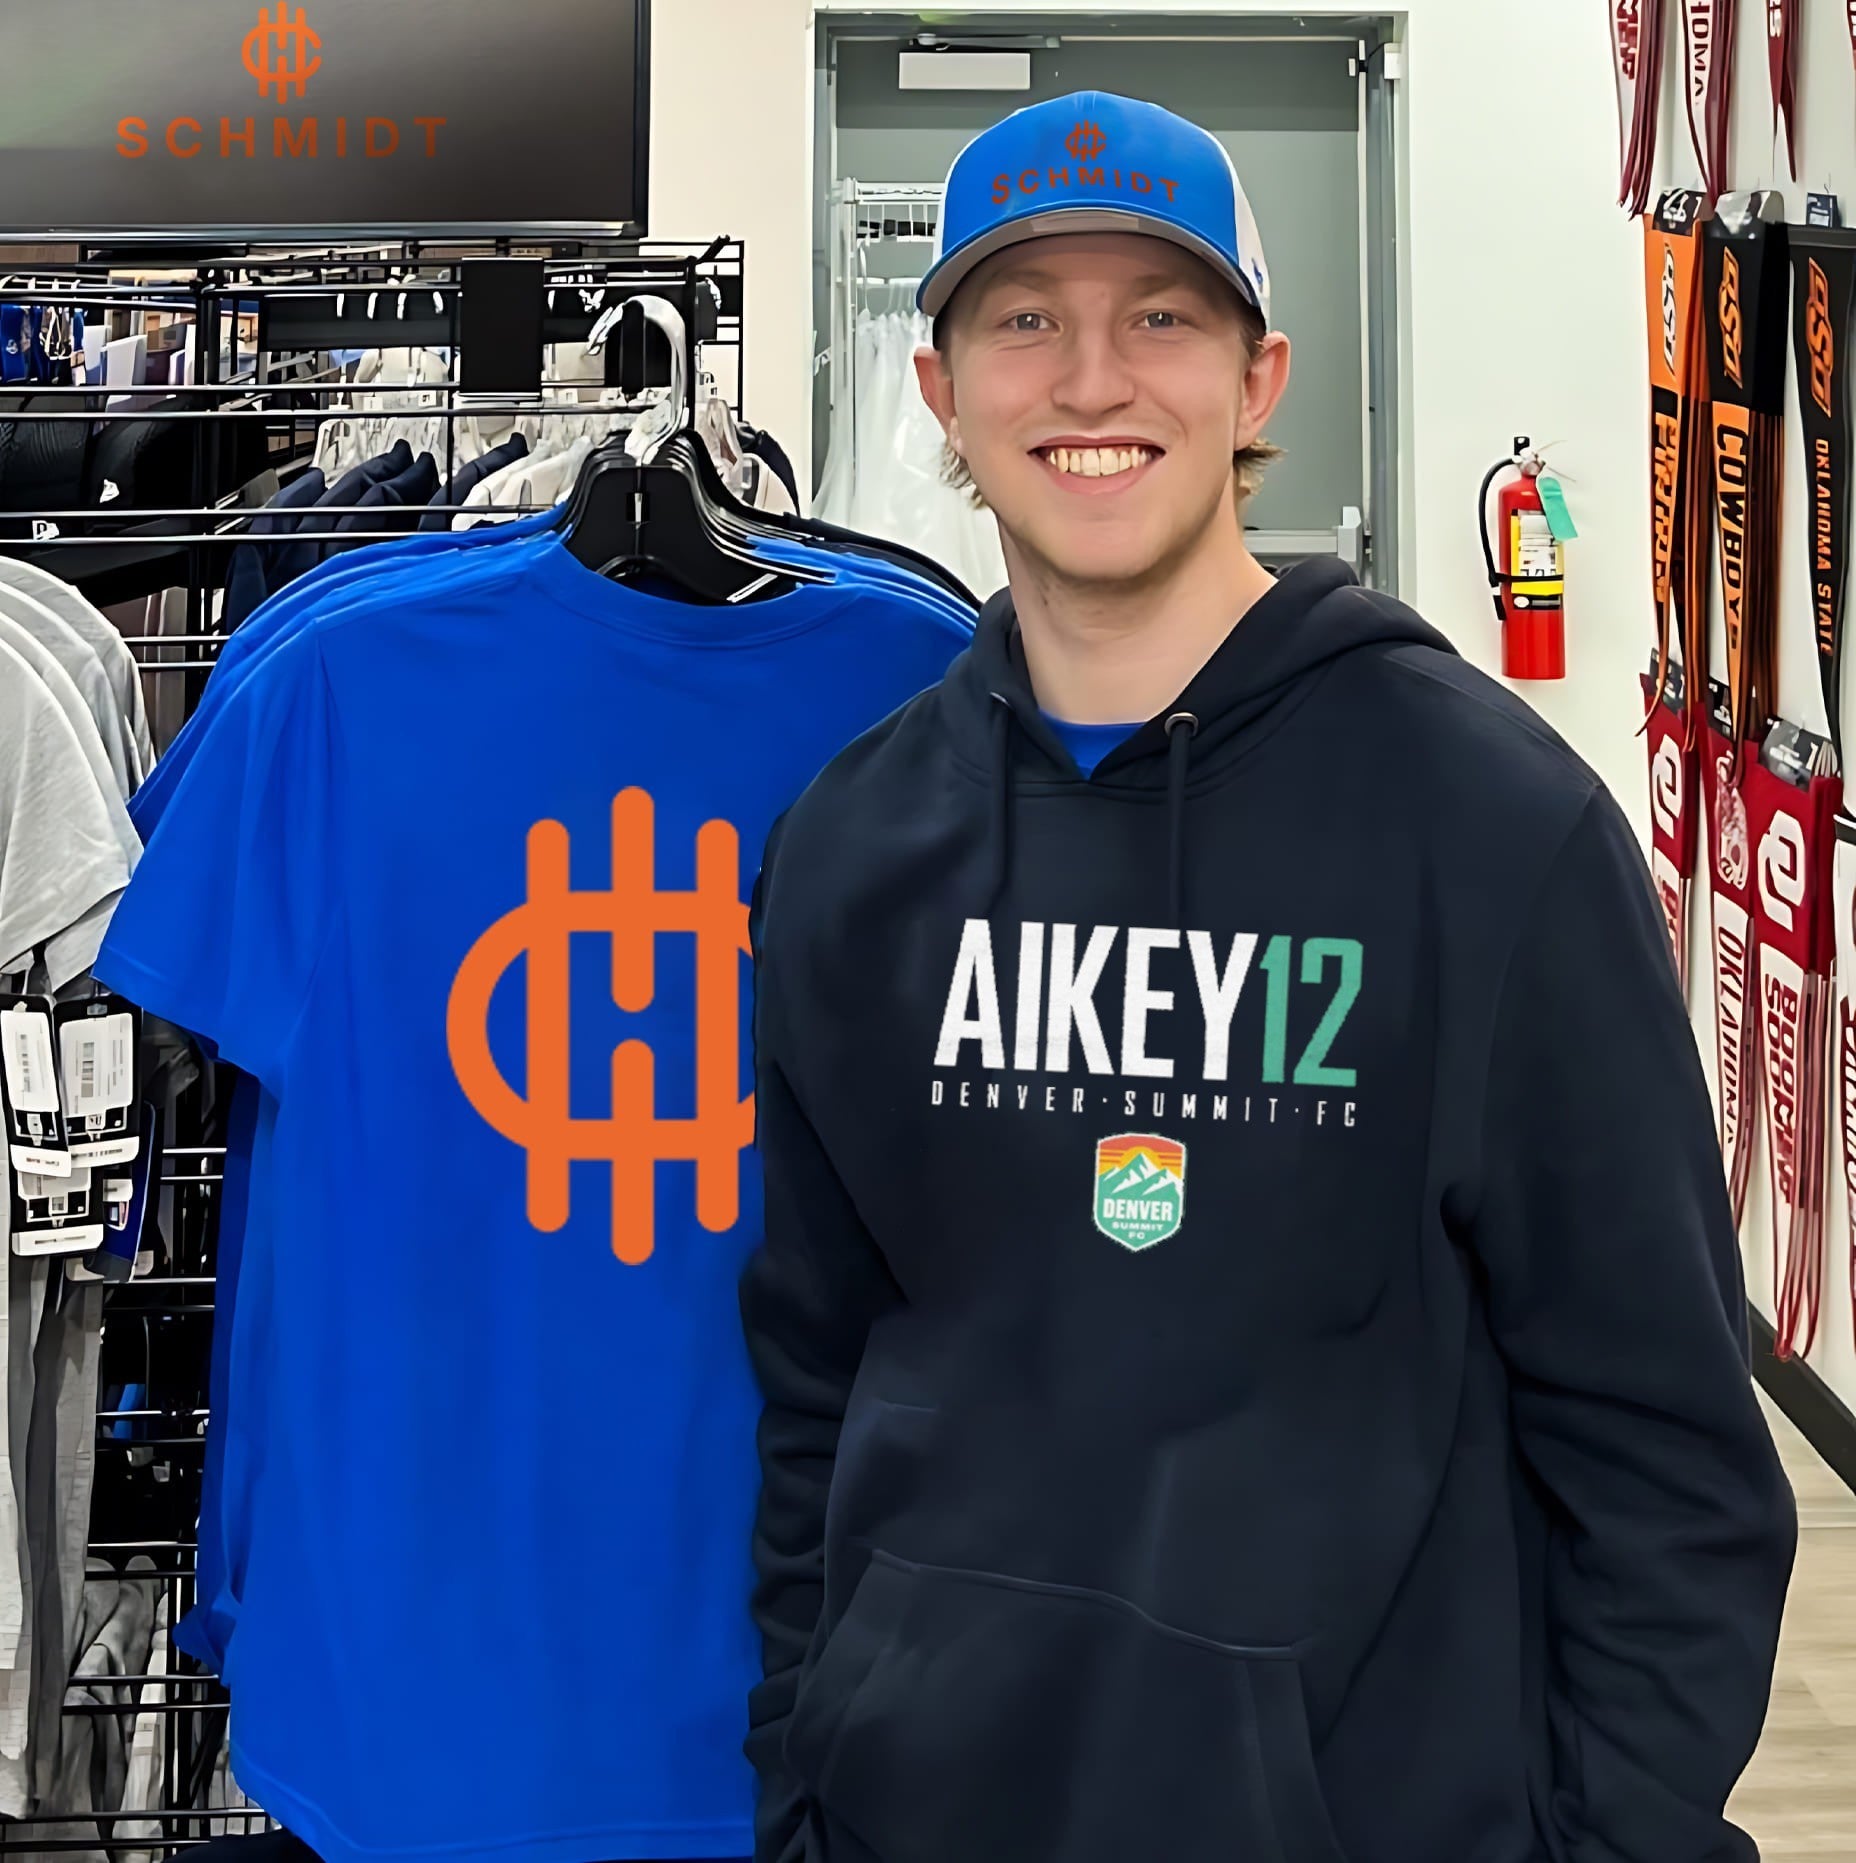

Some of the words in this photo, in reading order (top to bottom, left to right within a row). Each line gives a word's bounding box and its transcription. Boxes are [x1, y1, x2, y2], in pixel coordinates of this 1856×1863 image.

[115, 117, 448, 158] SCHMIDT
[991, 167, 1179, 204] SCHMIDT
[1815, 438, 1831, 570] OKLAHOMA
[1719, 926, 1744, 1143] OKLAHOMA
[1103, 1198, 1173, 1221] DENVER
[1112, 1221, 1164, 1231] SUMMIT
[1128, 1231, 1145, 1239] FC
